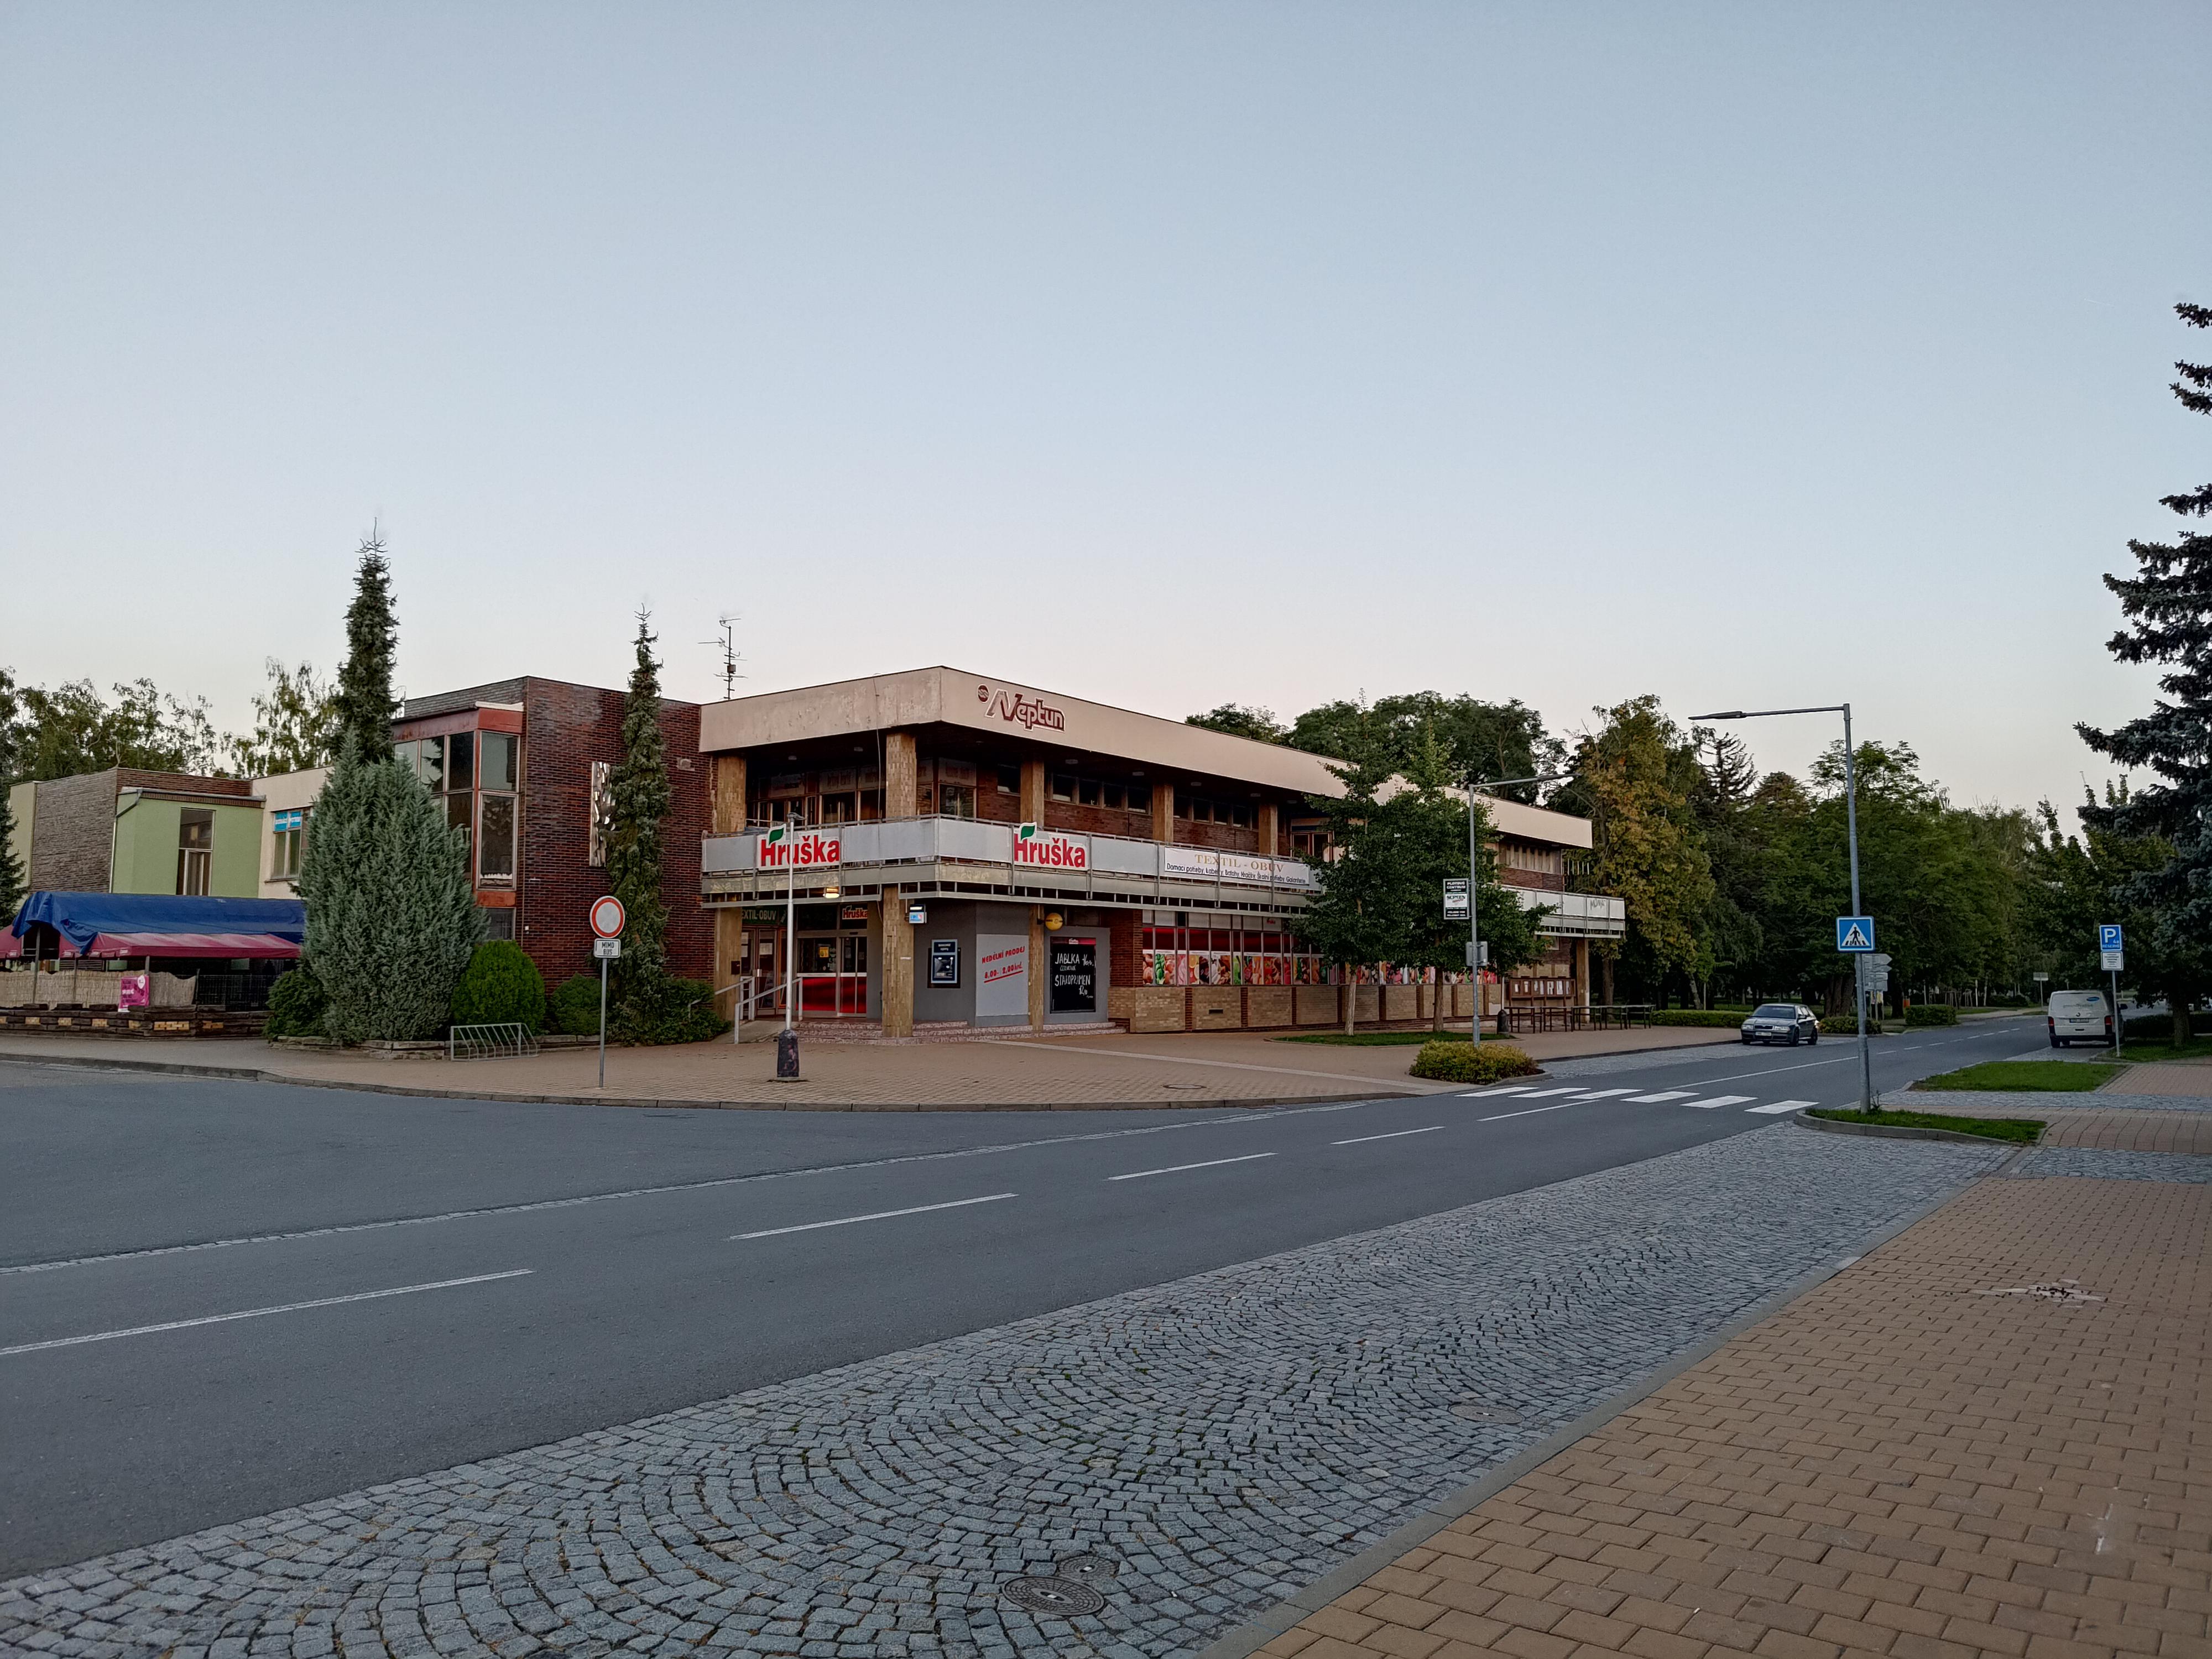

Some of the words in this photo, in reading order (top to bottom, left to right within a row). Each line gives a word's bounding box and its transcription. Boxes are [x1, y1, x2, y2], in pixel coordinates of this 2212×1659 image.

[985, 689, 1065, 732] Neptun
[761, 834, 840, 867] Hruška
[1014, 833, 1086, 868] Hruška
[1195, 854, 1240, 868] TEXTIL
[1251, 861, 1284, 873] OBUV
[2104, 928, 2116, 943] P
[1005, 946, 1025, 957] PRODEJ
[1055, 952, 1080, 964] JABLKA
